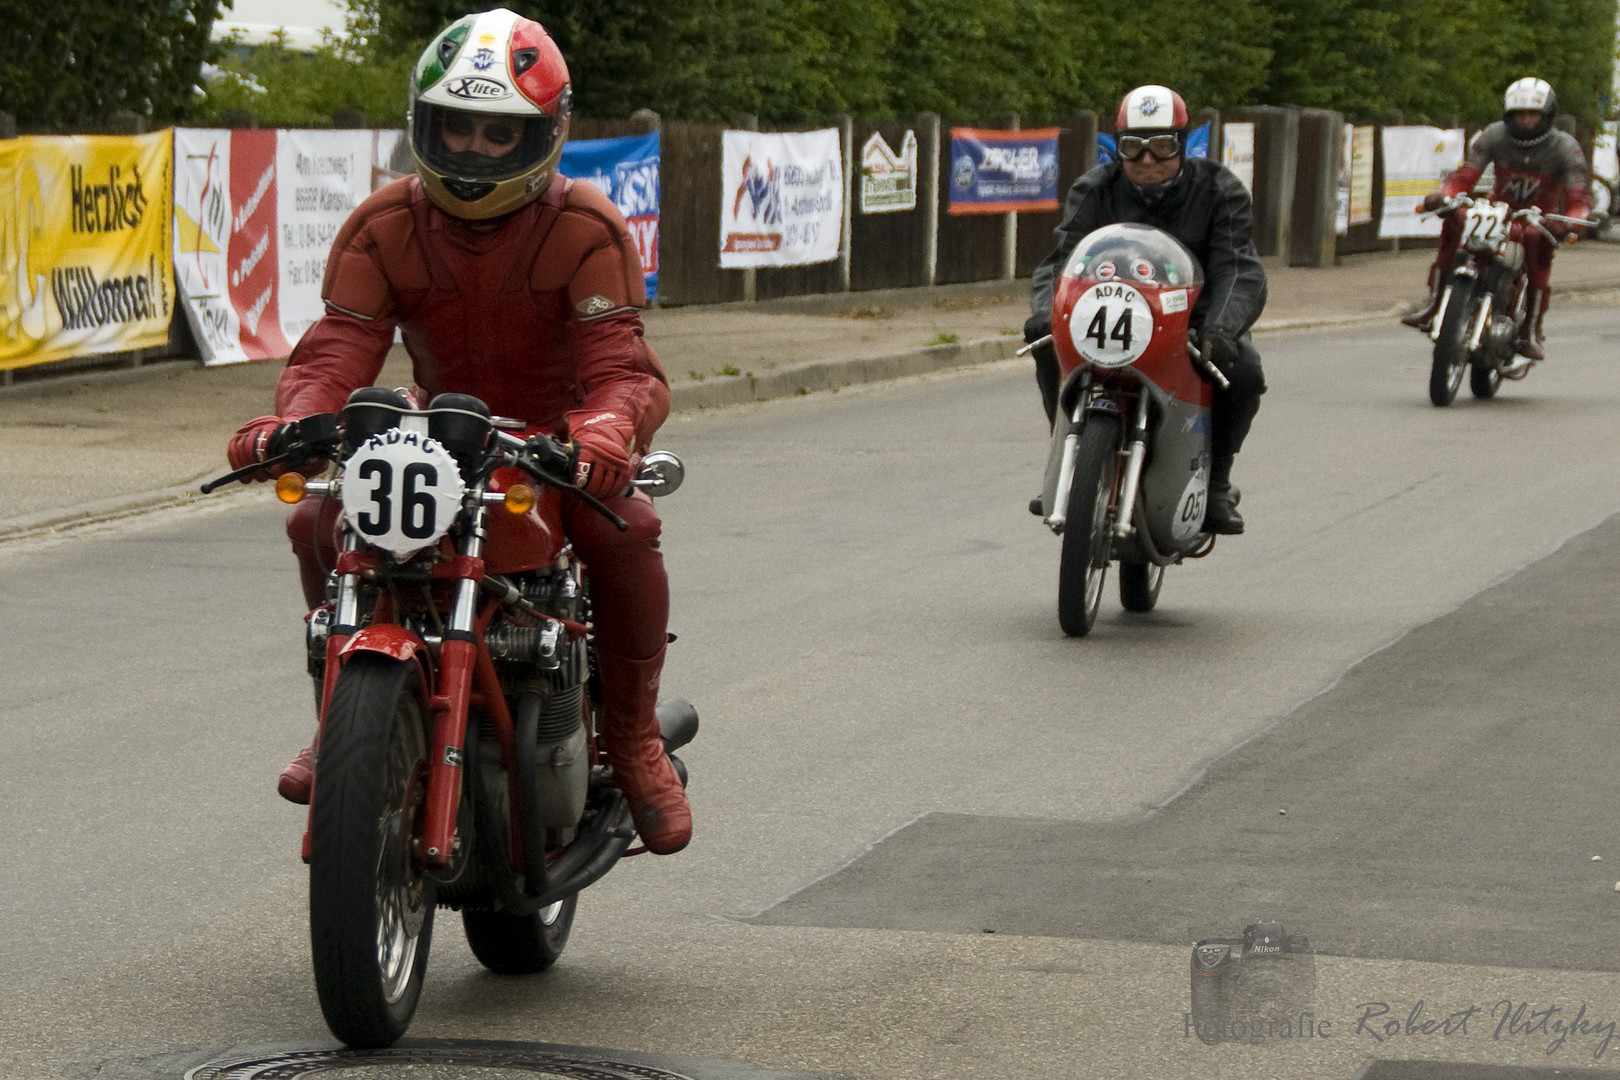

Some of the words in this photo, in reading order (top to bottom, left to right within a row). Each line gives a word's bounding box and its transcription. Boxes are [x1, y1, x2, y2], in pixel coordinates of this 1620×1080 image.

[1470, 213, 1498, 240] 22
[1095, 284, 1136, 303] ADAC
[1086, 305, 1133, 351] 44
[369, 431, 434, 454] ADAC
[358, 458, 438, 539] 36
